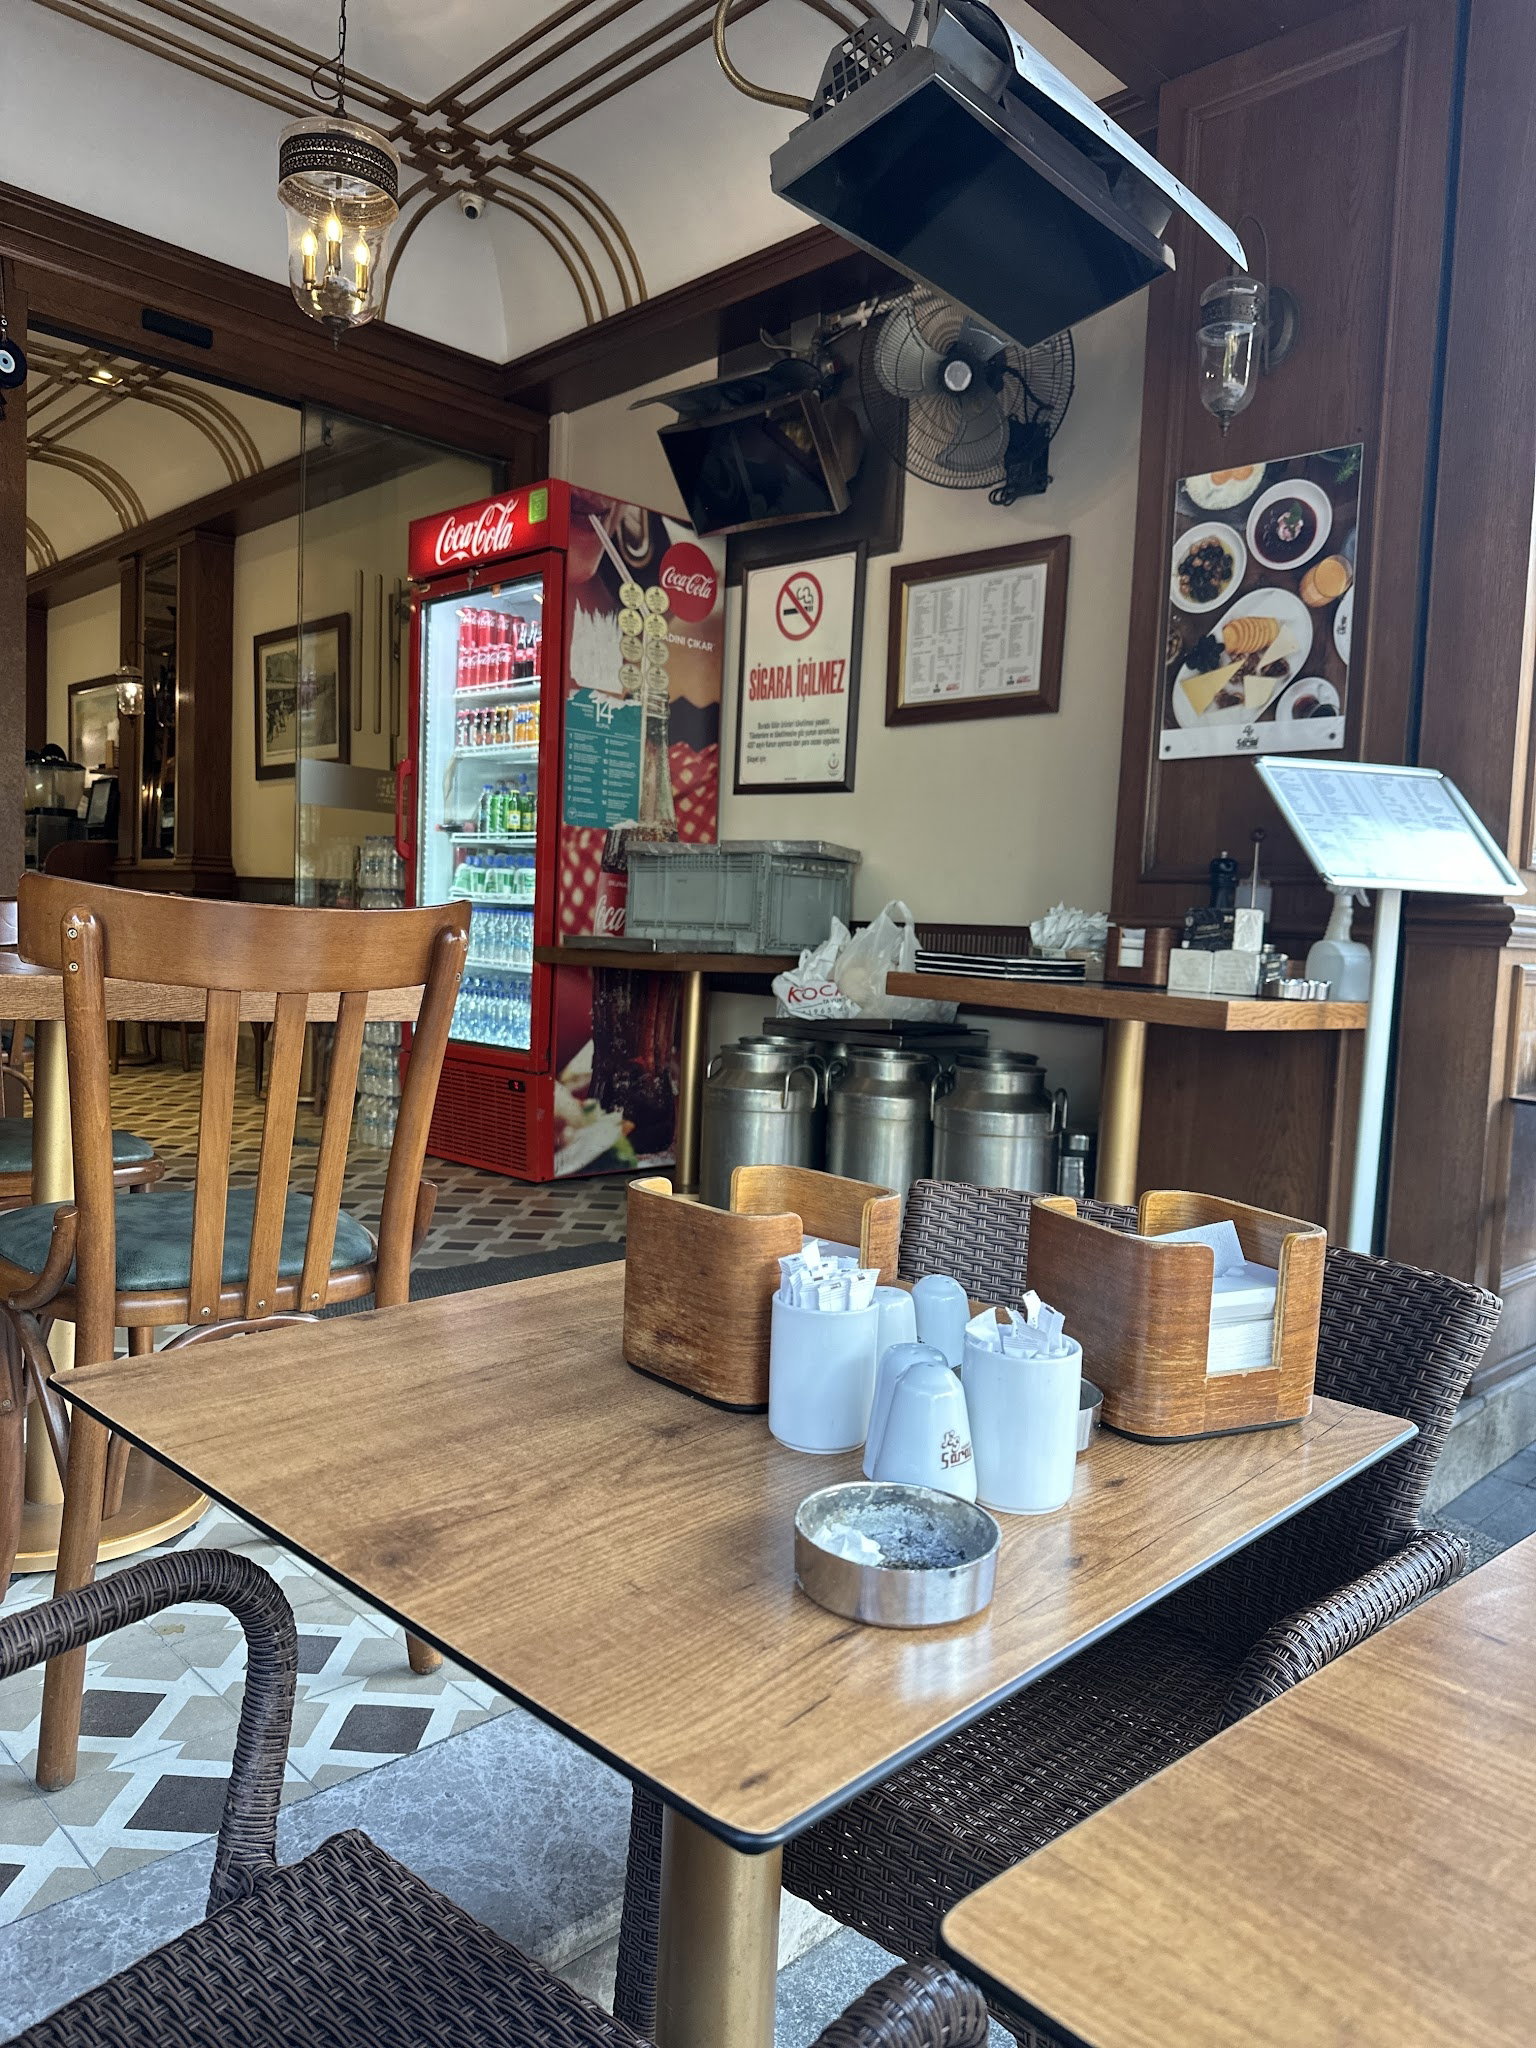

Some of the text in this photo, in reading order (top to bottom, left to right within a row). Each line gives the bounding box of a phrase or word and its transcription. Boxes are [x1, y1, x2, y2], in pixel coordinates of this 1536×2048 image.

[435, 499, 519, 566] Coca-Cola
[662, 566, 714, 599] Coca-Cola
[687, 638, 714, 653] ÇIKAR
[749, 657, 846, 703] SİGARA İÇİLMEZ
[592, 698, 614, 725] 14
[941, 1447, 972, 1470] Sara
